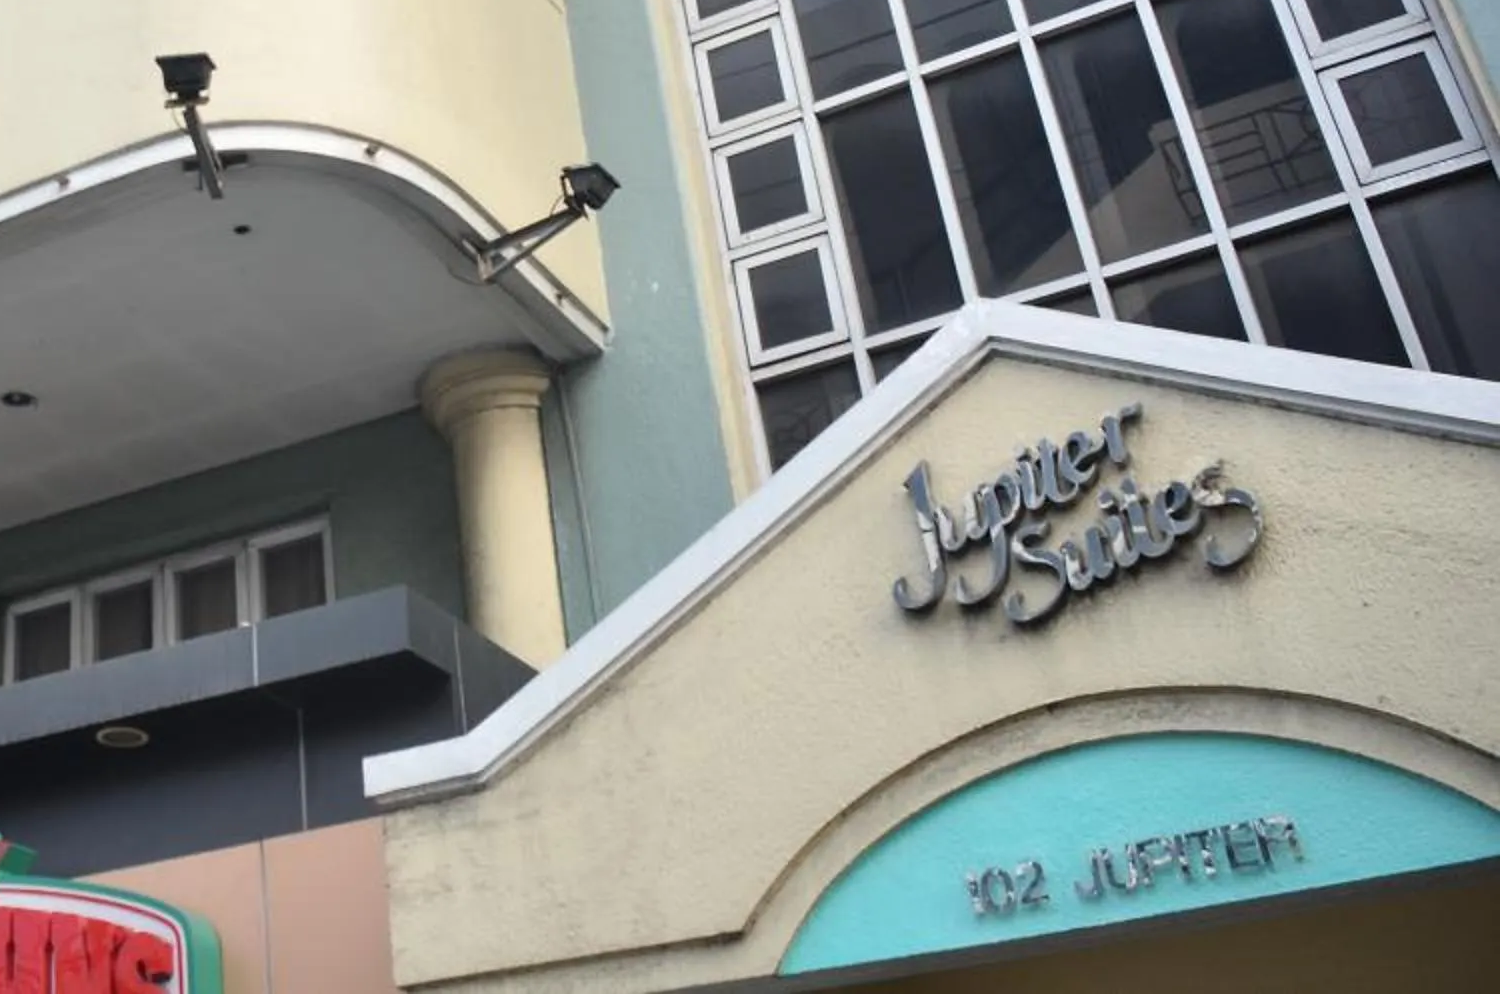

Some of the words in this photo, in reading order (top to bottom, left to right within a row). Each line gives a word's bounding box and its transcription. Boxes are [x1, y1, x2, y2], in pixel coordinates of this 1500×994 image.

[893, 402, 1143, 612] Jupiter
[1005, 459, 1263, 624] Suites
[1074, 814, 1306, 901] JUPITER
